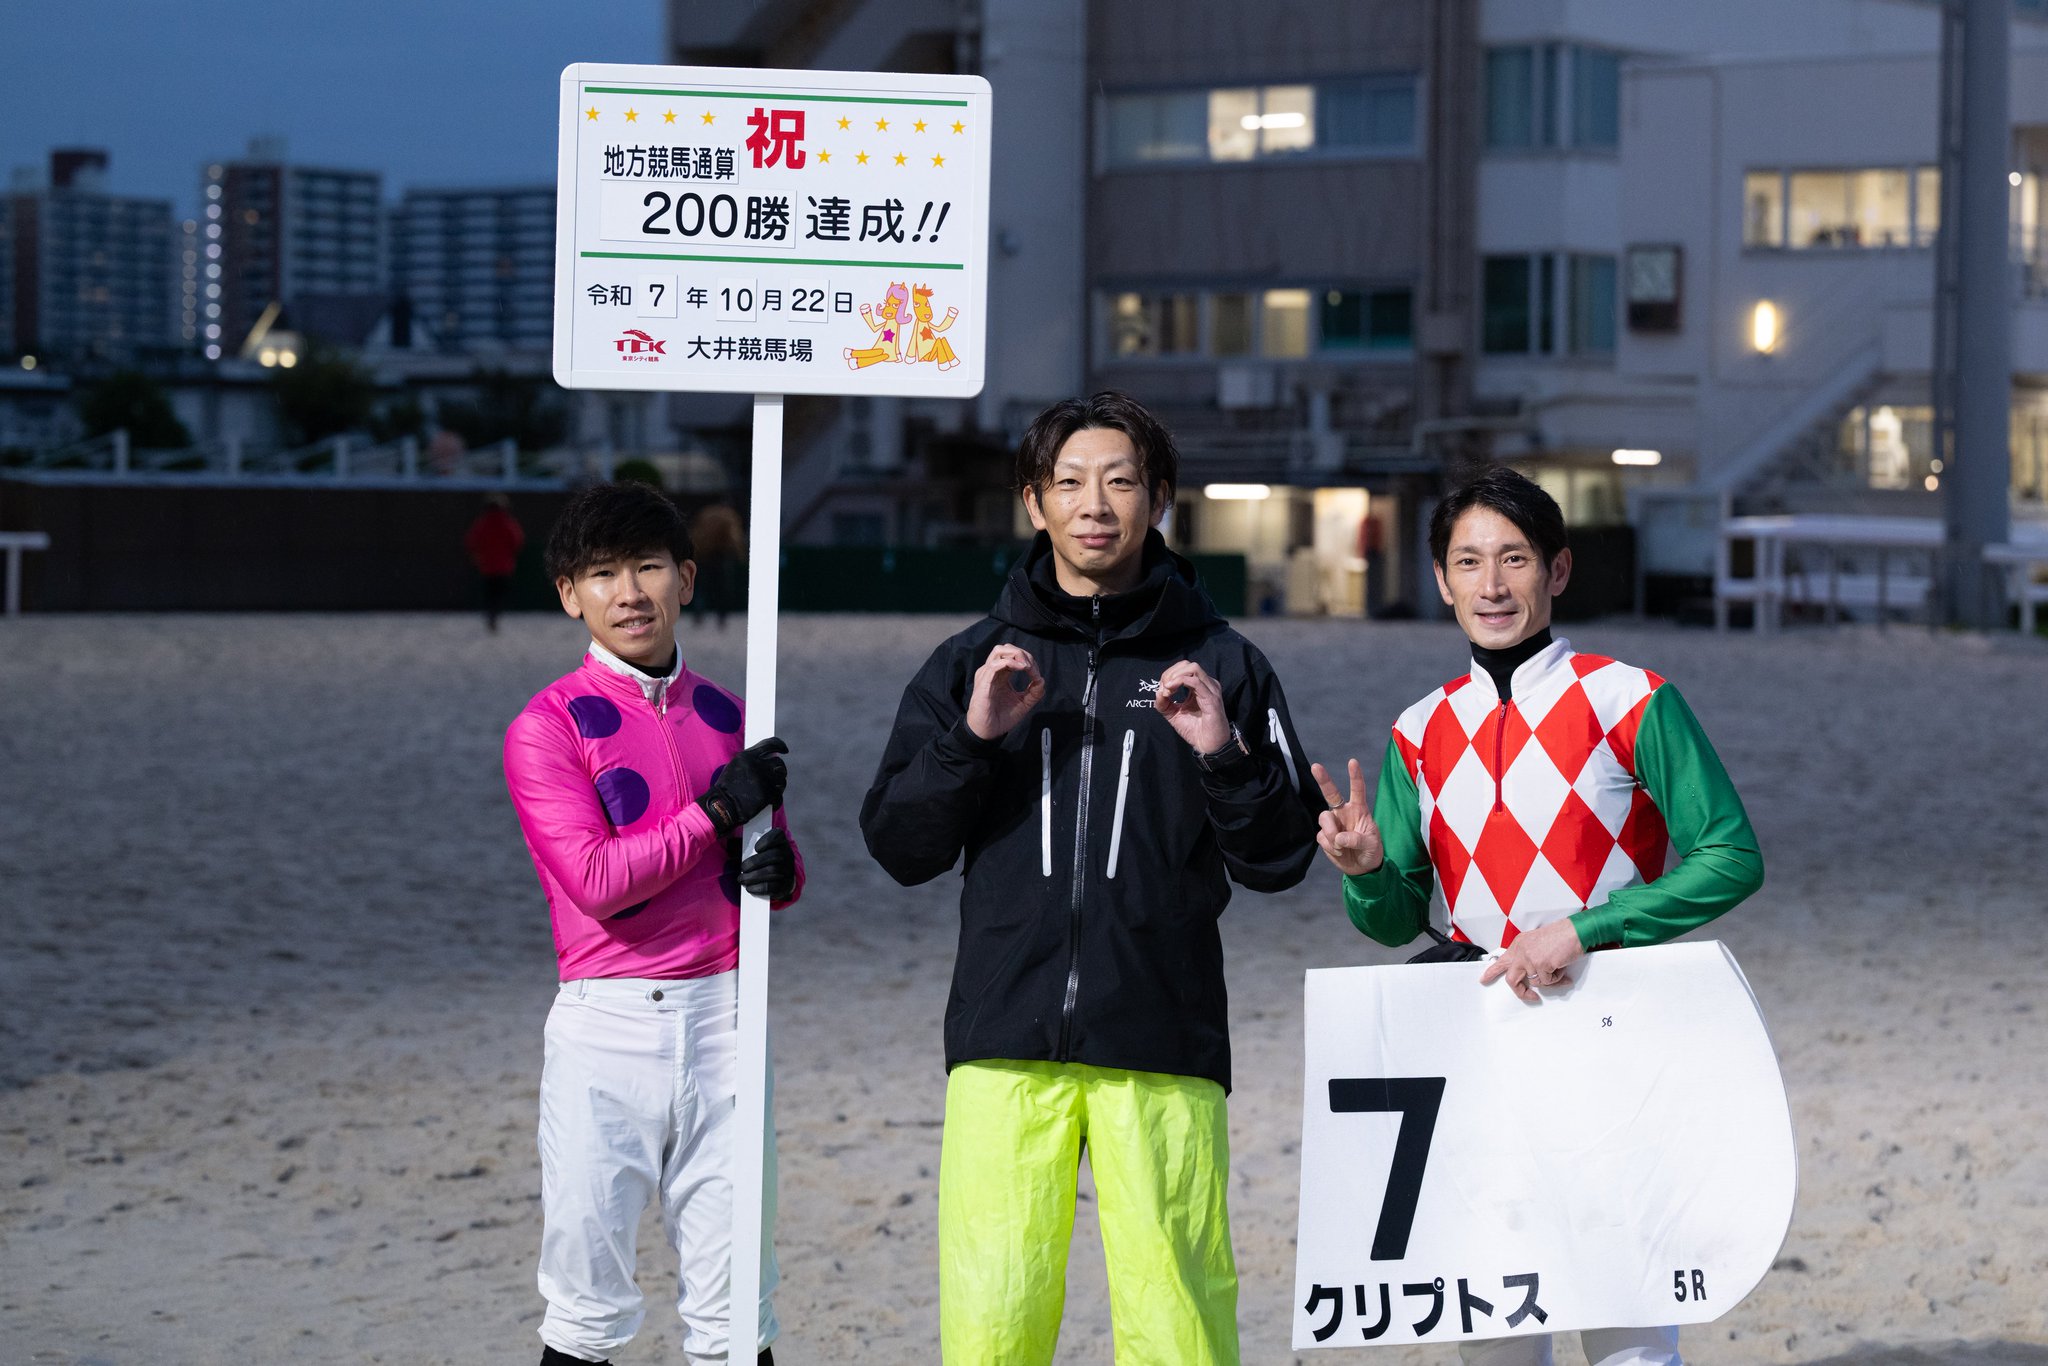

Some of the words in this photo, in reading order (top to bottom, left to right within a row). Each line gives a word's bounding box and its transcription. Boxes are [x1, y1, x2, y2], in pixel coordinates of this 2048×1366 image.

[604, 145, 735, 180] 地方競馬通算
[745, 107, 807, 170] 祝
[613, 337, 667, 355] TCK
[687, 335, 813, 363] 大井競馬場
[1329, 1077, 1447, 1261] 7
[1304, 1272, 1549, 1343] クリプトス
